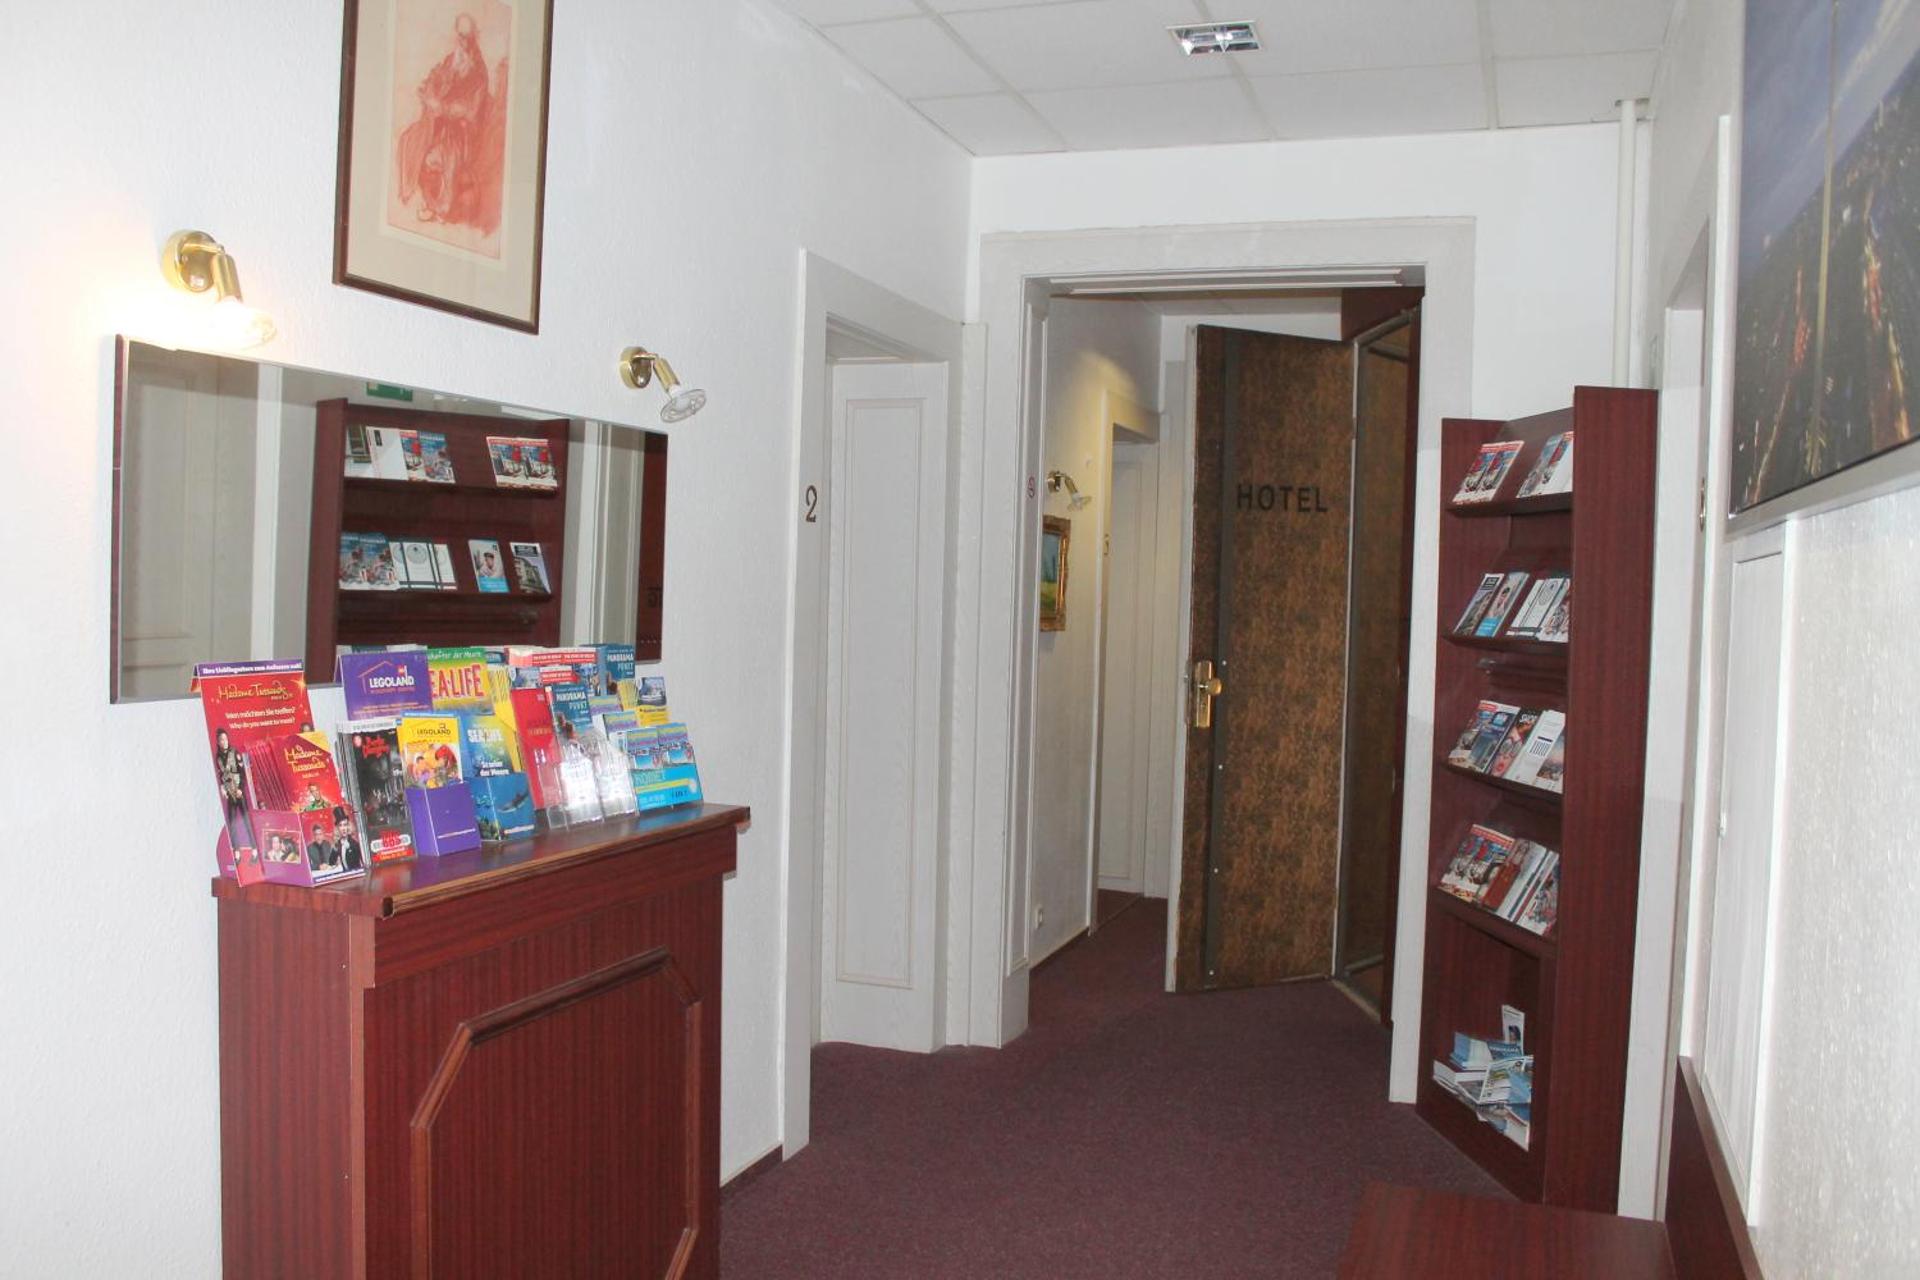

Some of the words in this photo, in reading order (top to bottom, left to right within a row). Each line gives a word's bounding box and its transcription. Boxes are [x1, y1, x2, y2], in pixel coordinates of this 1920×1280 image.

[805, 484, 818, 522] 2
[1236, 484, 1328, 512] HOTEL
[219, 684, 255, 700] Madame
[250, 680, 289, 698] Tussauds
[369, 675, 415, 688] LEGOLAND
[429, 669, 449, 697] EA
[449, 663, 485, 697] LIFE
[416, 726, 451, 736] LEGOLAND
[284, 745, 322, 762] Madame
